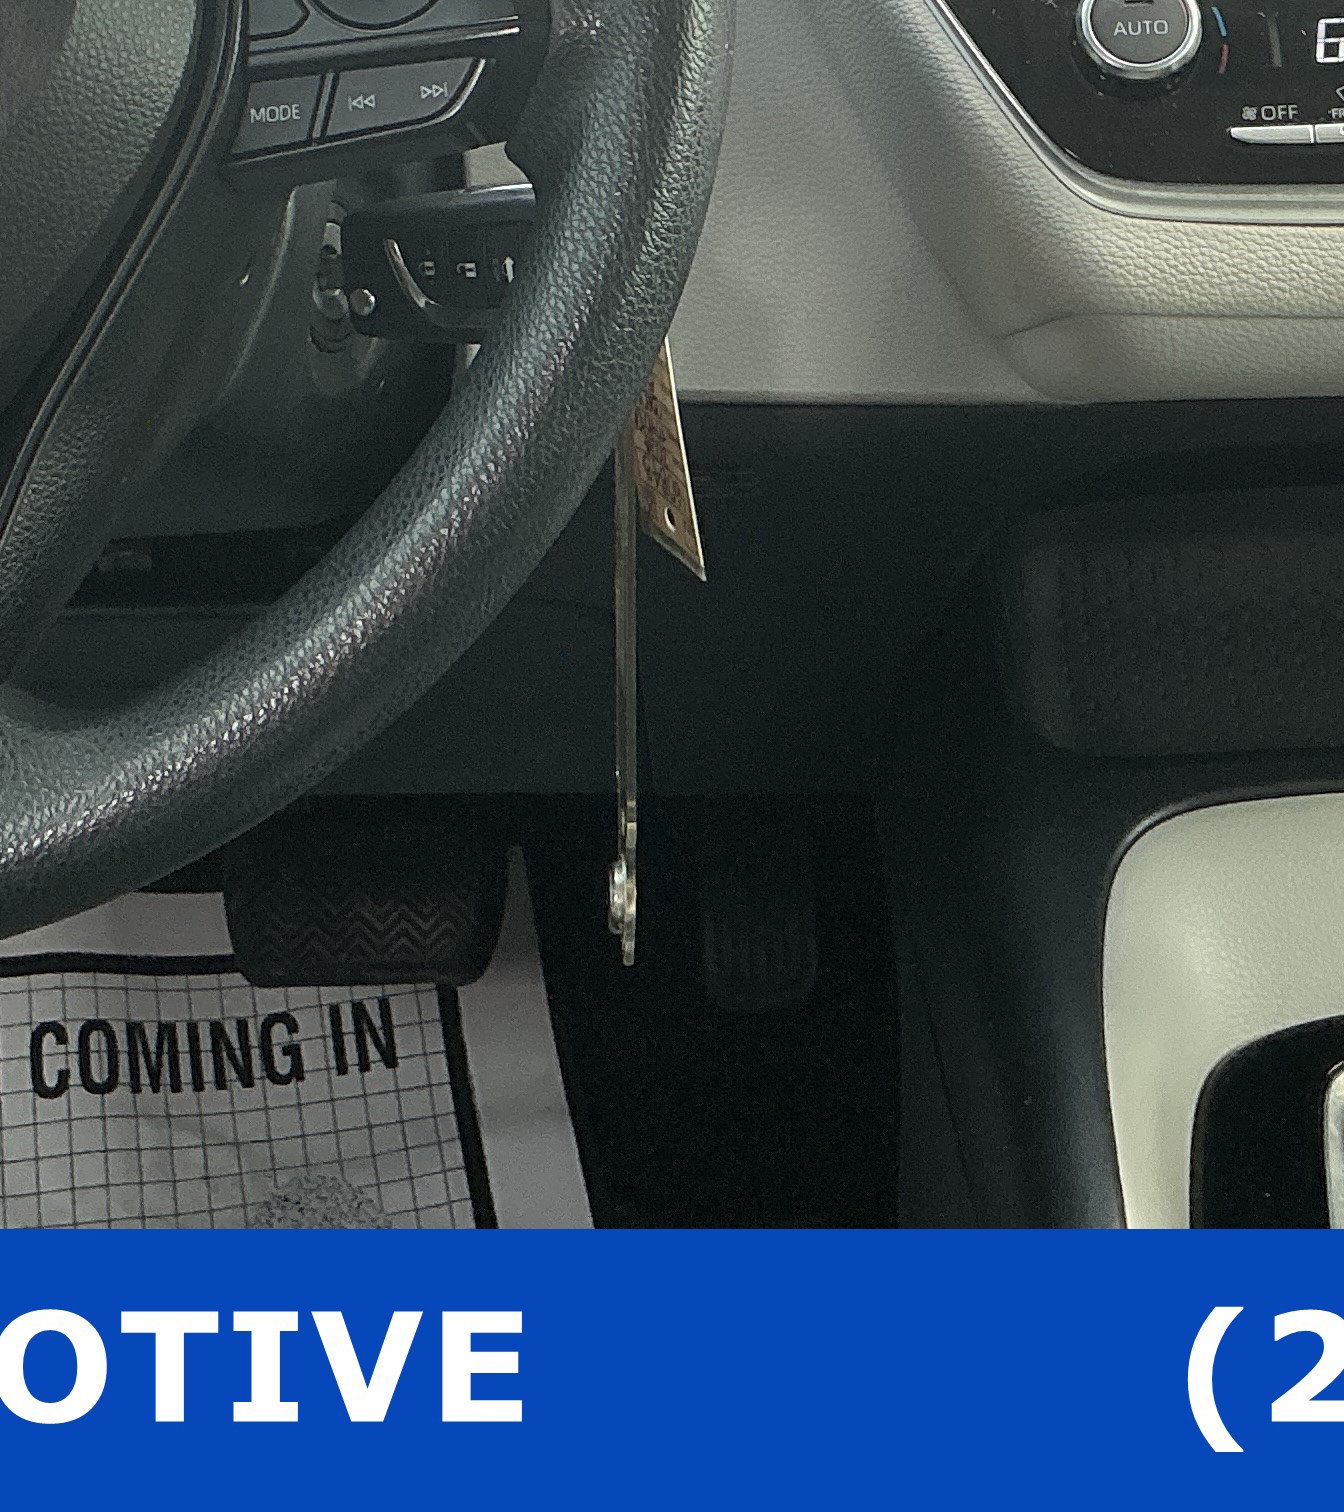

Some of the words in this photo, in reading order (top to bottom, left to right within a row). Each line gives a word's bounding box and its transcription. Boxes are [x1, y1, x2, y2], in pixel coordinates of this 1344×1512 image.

[1113, 19, 1170, 37] AUTO
[249, 103, 301, 124] MODE
[1260, 104, 1299, 121] OFF
[29, 1011, 302, 1100] COMING
[327, 996, 399, 1077] IN
